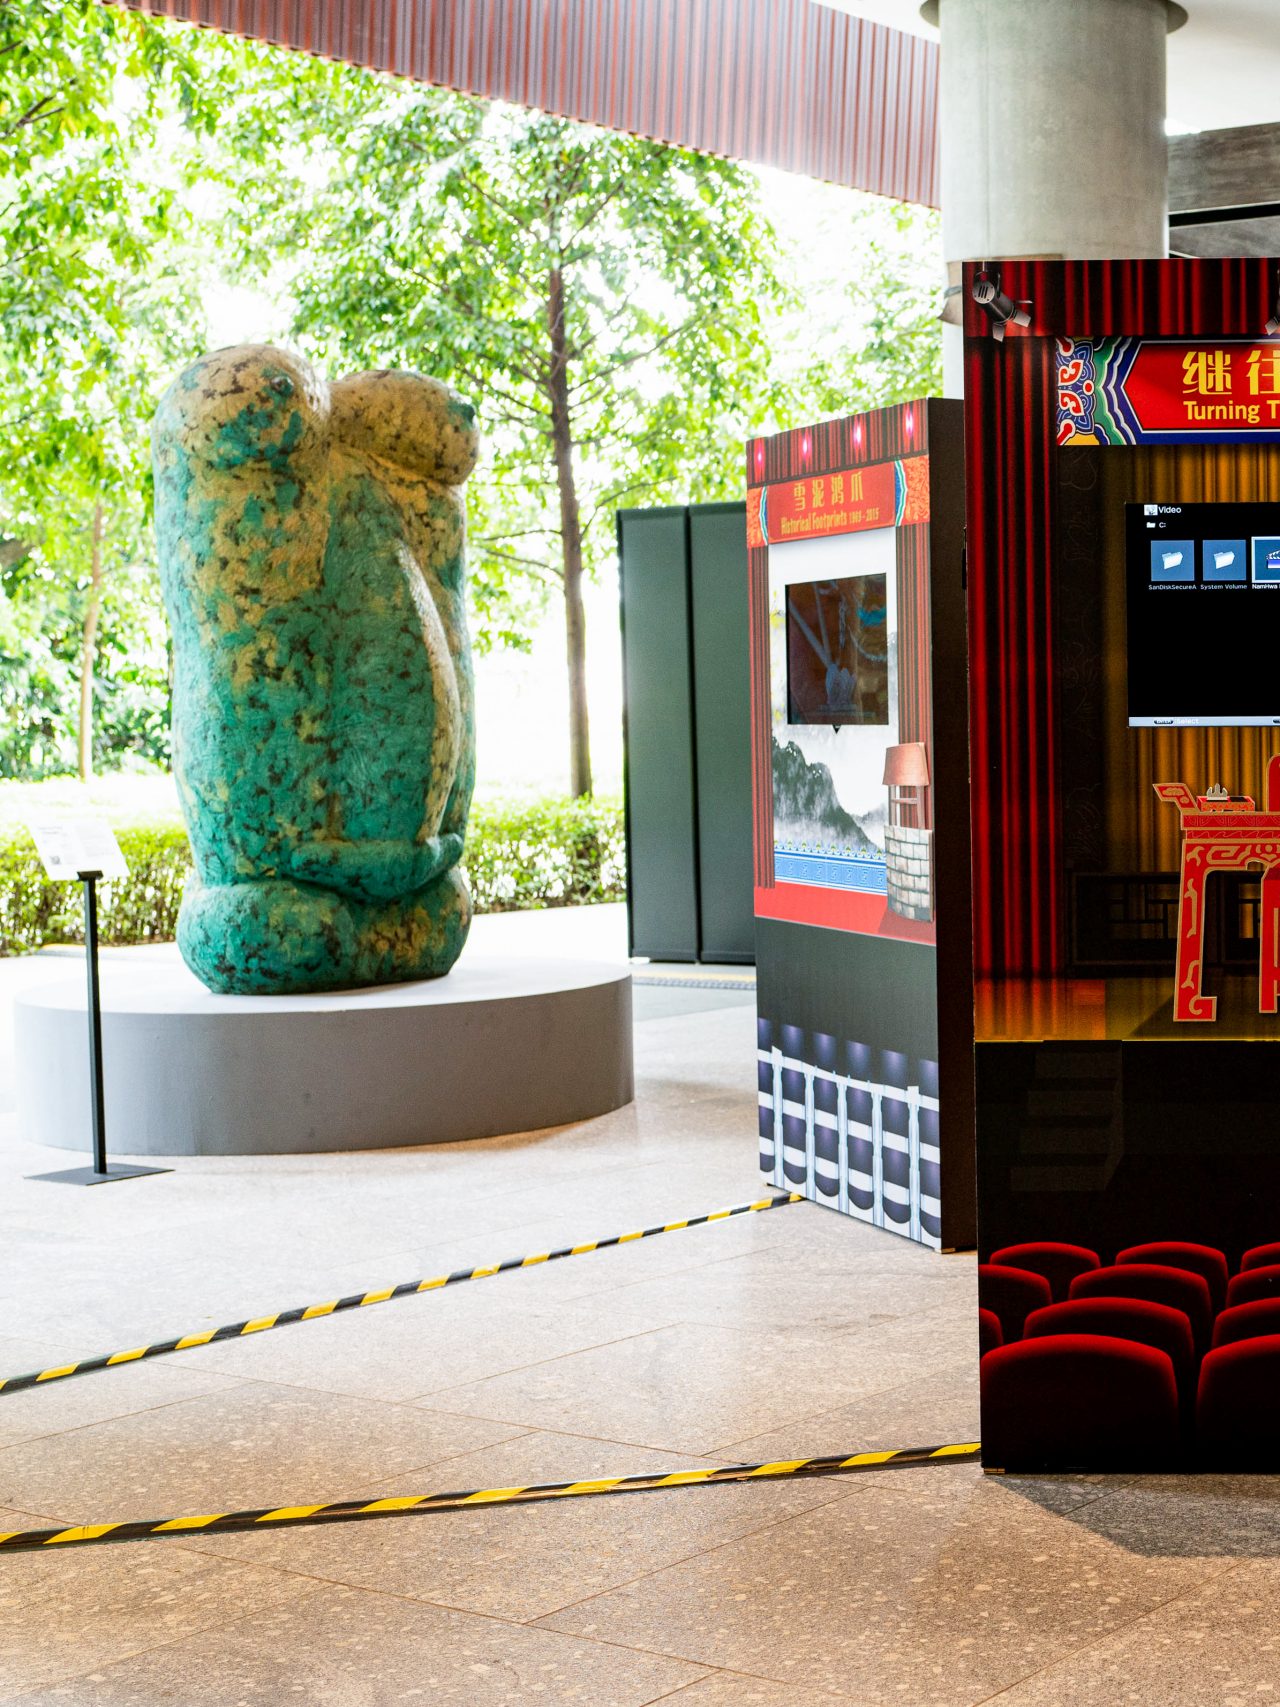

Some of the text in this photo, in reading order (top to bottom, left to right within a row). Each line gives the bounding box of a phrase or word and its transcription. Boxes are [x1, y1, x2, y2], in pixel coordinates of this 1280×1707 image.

[1183, 401, 1260, 423] Turning
[1158, 506, 1182, 514] Video
[812, 510, 848, 533] Footprints
